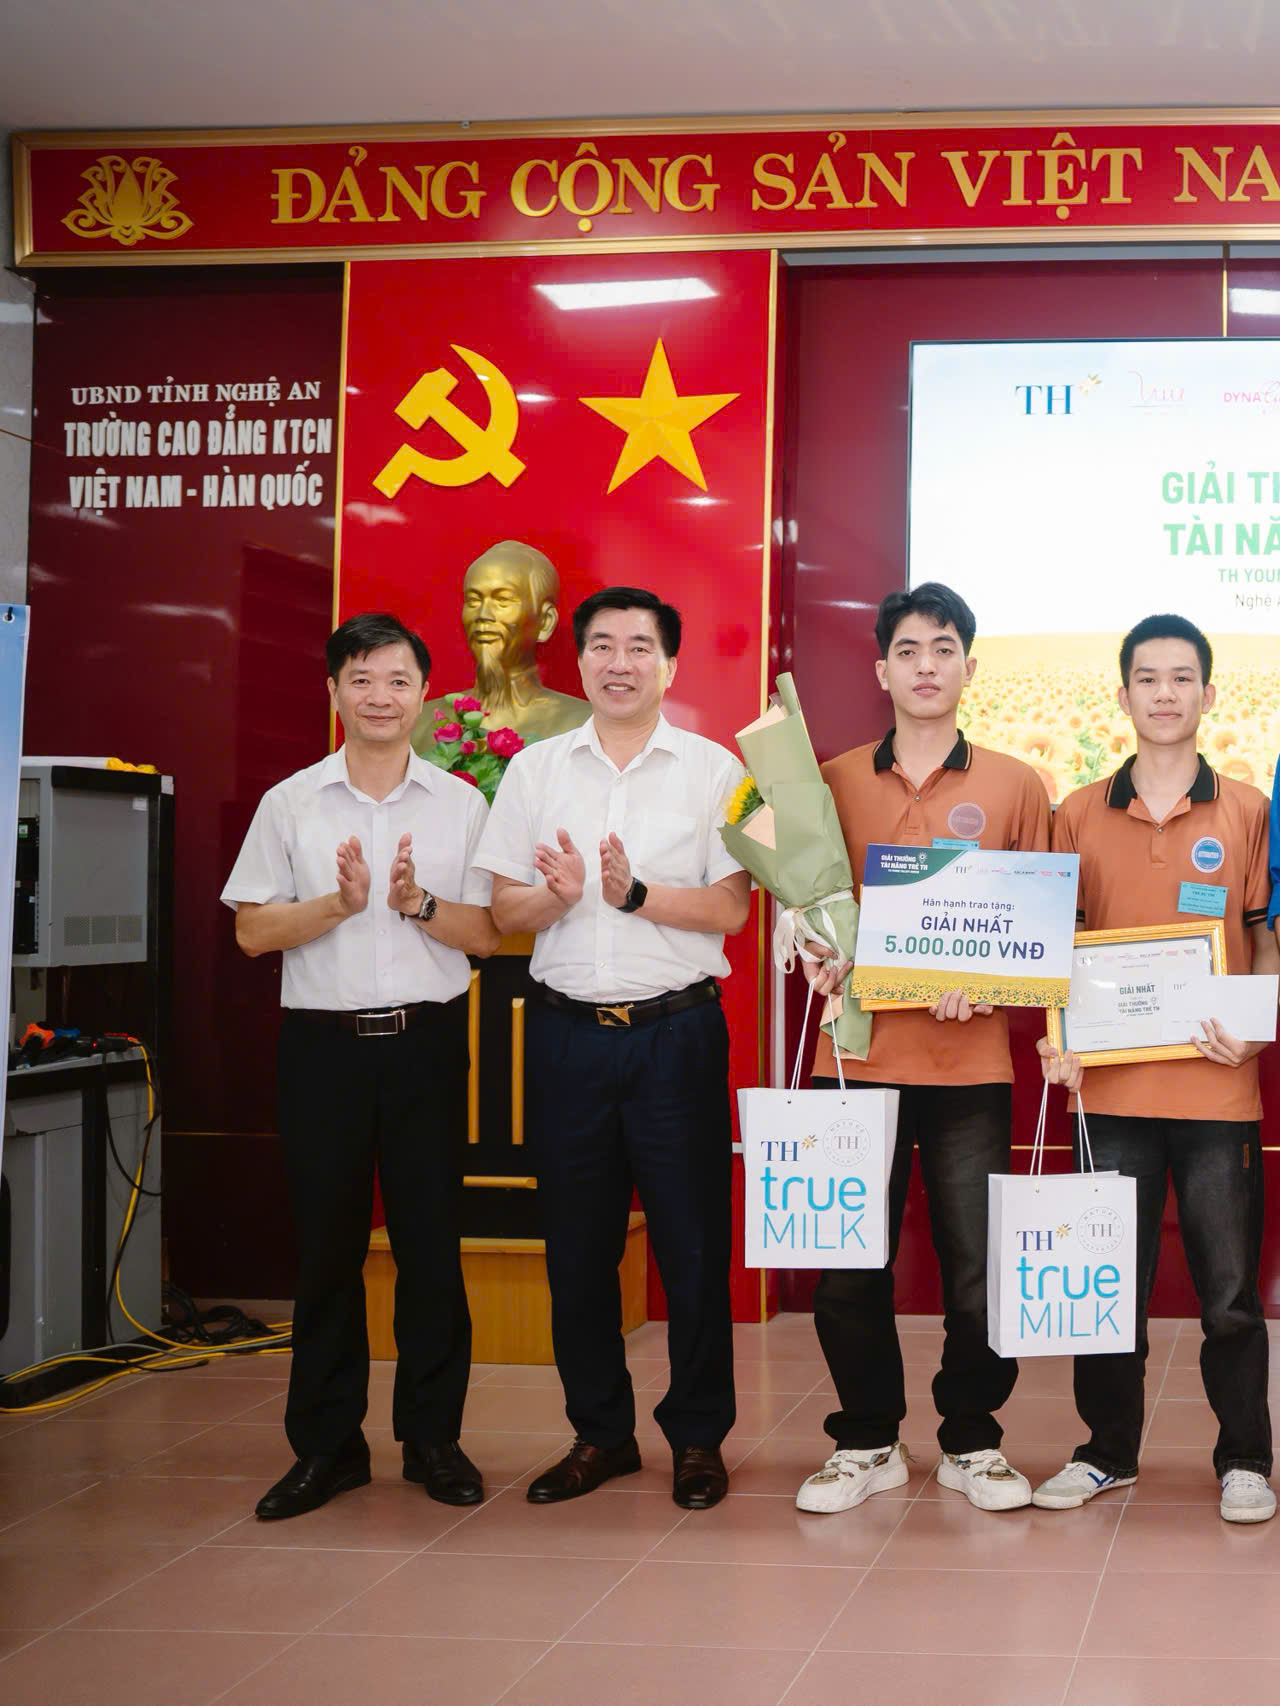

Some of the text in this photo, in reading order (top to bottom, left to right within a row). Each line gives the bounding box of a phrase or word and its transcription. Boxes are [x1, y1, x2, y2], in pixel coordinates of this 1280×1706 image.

[270, 145, 487, 224] ĐẢNG
[510, 141, 720, 232] CỘNG
[751, 132, 916, 211] SẢN
[940, 132, 1143, 220] VIỆT
[71, 376, 321, 407] UBND TỈNH NGHỆ AN
[1014, 384, 1074, 415] TH
[64, 403, 333, 457] TRƯỜNG CAO ĐẲNG KTCN
[69, 460, 323, 516] VIỆT NAM - HÀN QUỐC
[1162, 460, 1235, 504] GIẢI
[1163, 513, 1223, 556] TÀI
[1218, 568, 1238, 583] TH
[922, 898, 941, 907] Hân
[943, 899, 967, 908] hạnh
[969, 901, 989, 909] trao
[921, 912, 1014, 934] GIẢI NHẤT
[884, 935, 1045, 960] 5.000.000 VNĐ
[760, 1140, 800, 1161] TH
[834, 1135, 859, 1150] TH
[760, 1166, 867, 1212] true
[763, 1212, 867, 1250] MILK
[1016, 1230, 1054, 1251] TH
[1087, 1223, 1113, 1238] TH
[1016, 1256, 1121, 1301] true
[1020, 1299, 1121, 1340] MILK
